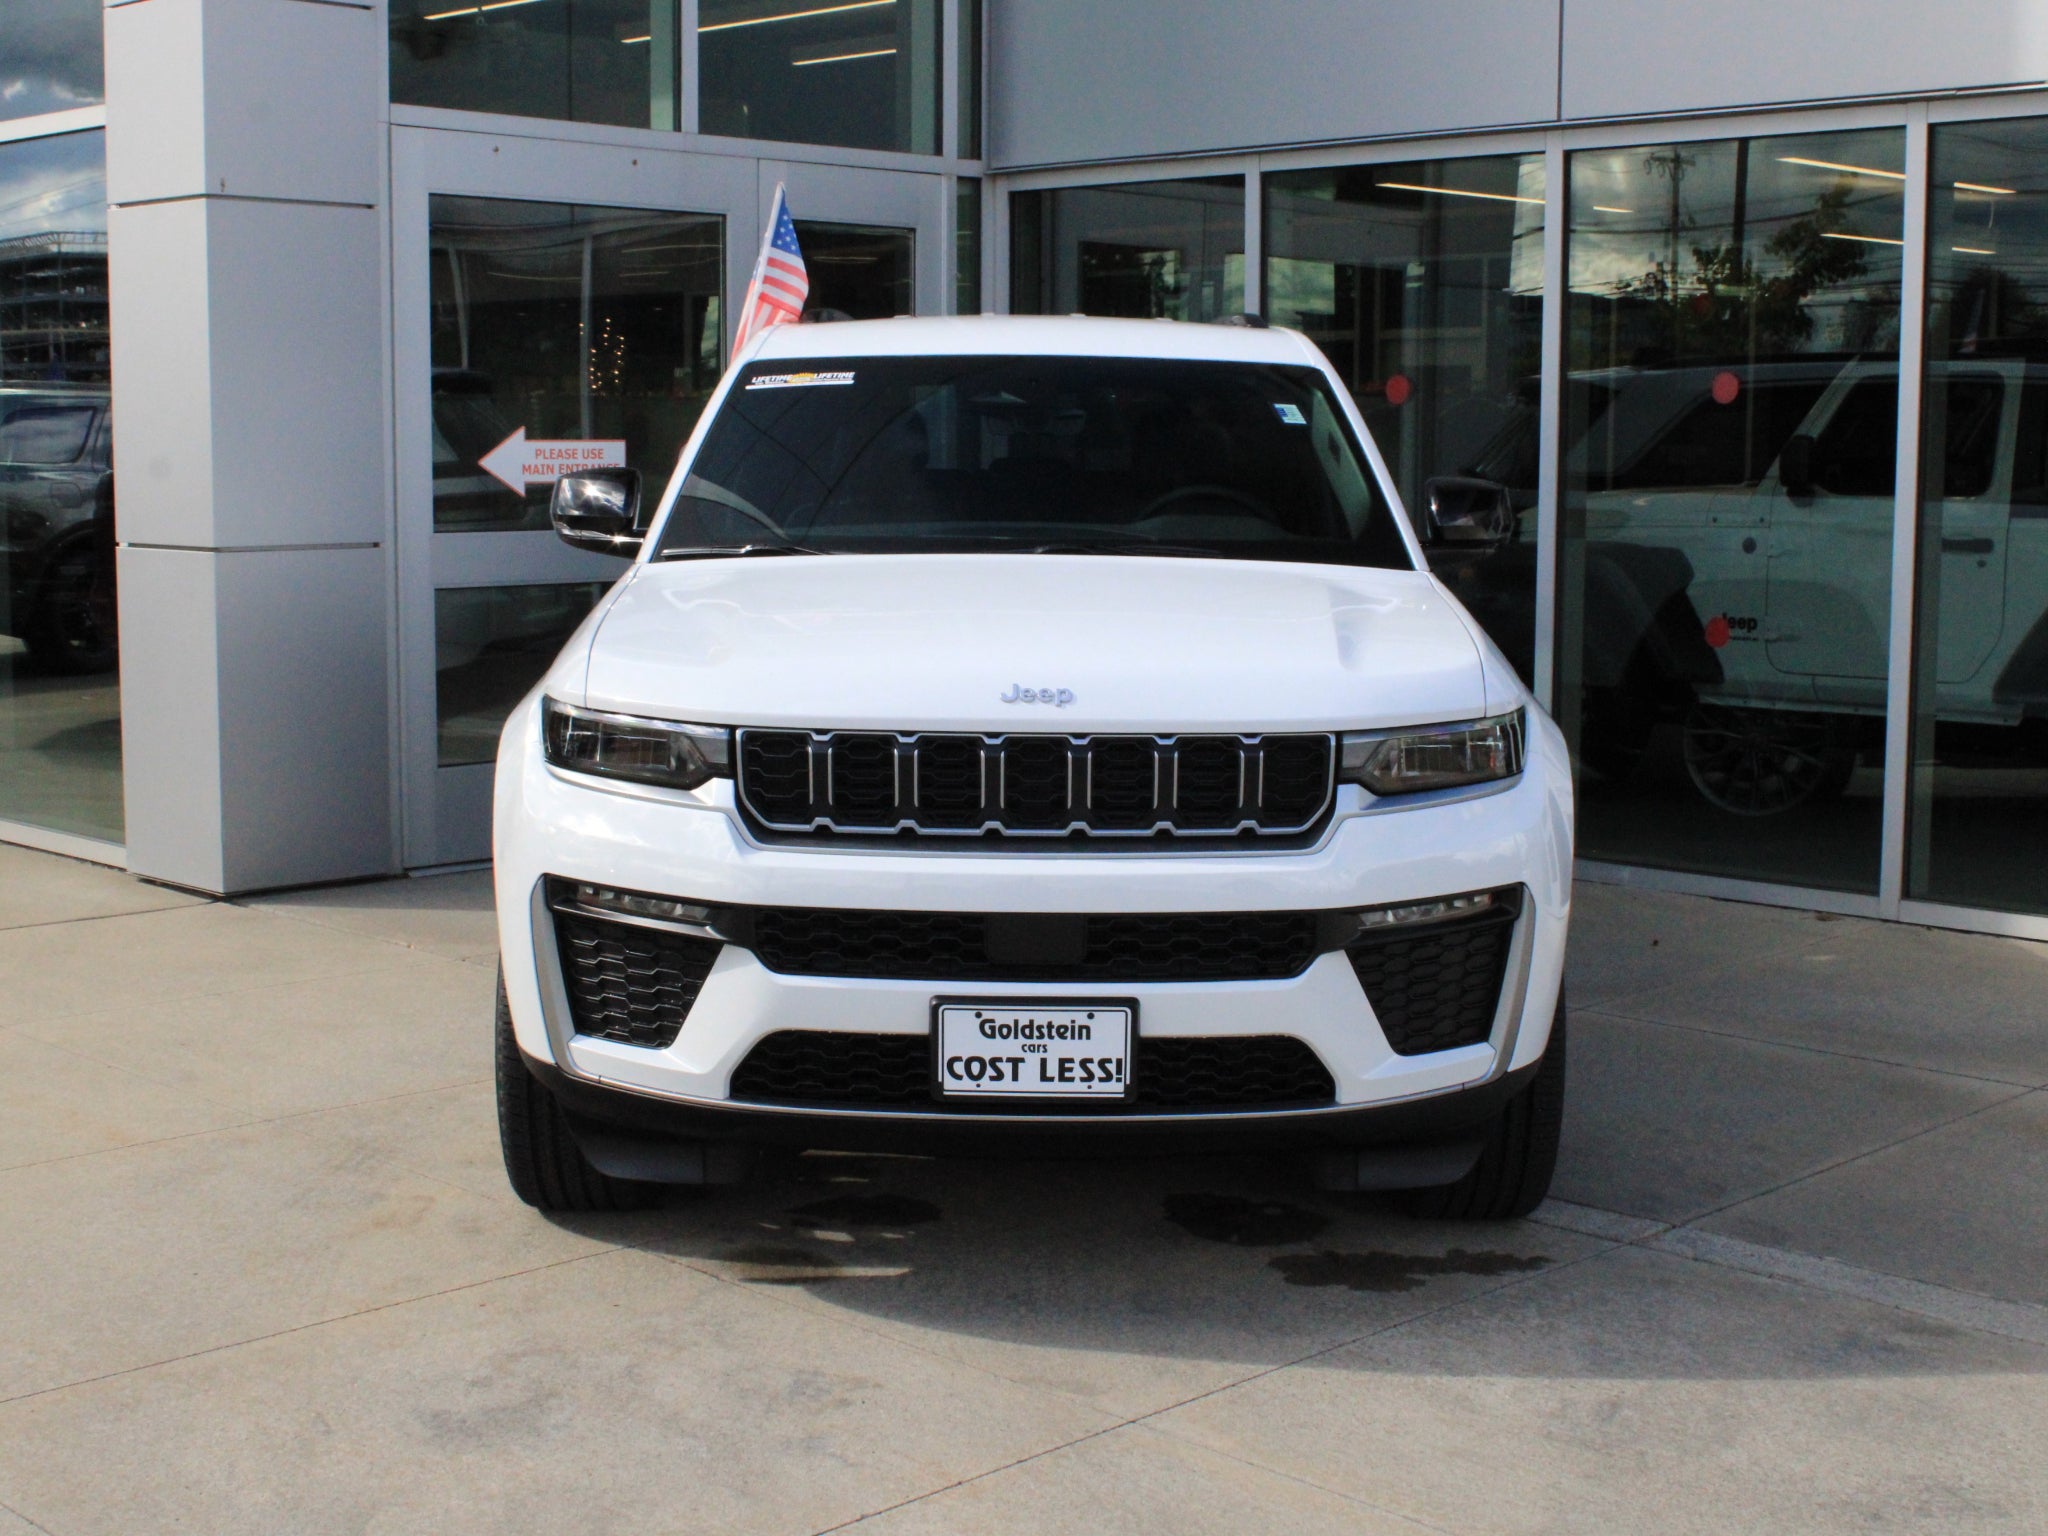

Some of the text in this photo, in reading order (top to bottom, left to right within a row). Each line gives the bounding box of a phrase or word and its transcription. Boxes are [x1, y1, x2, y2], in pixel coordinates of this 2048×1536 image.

[813, 372, 855, 380] LIFETIME
[535, 448, 604, 460] PLEASE USE
[522, 464, 554, 475] MAIN
[1000, 683, 1075, 707] Jeep
[979, 1018, 1091, 1040] Goldstein
[1021, 1044, 1048, 1054] cars
[946, 1056, 1123, 1083] COST LESS!
